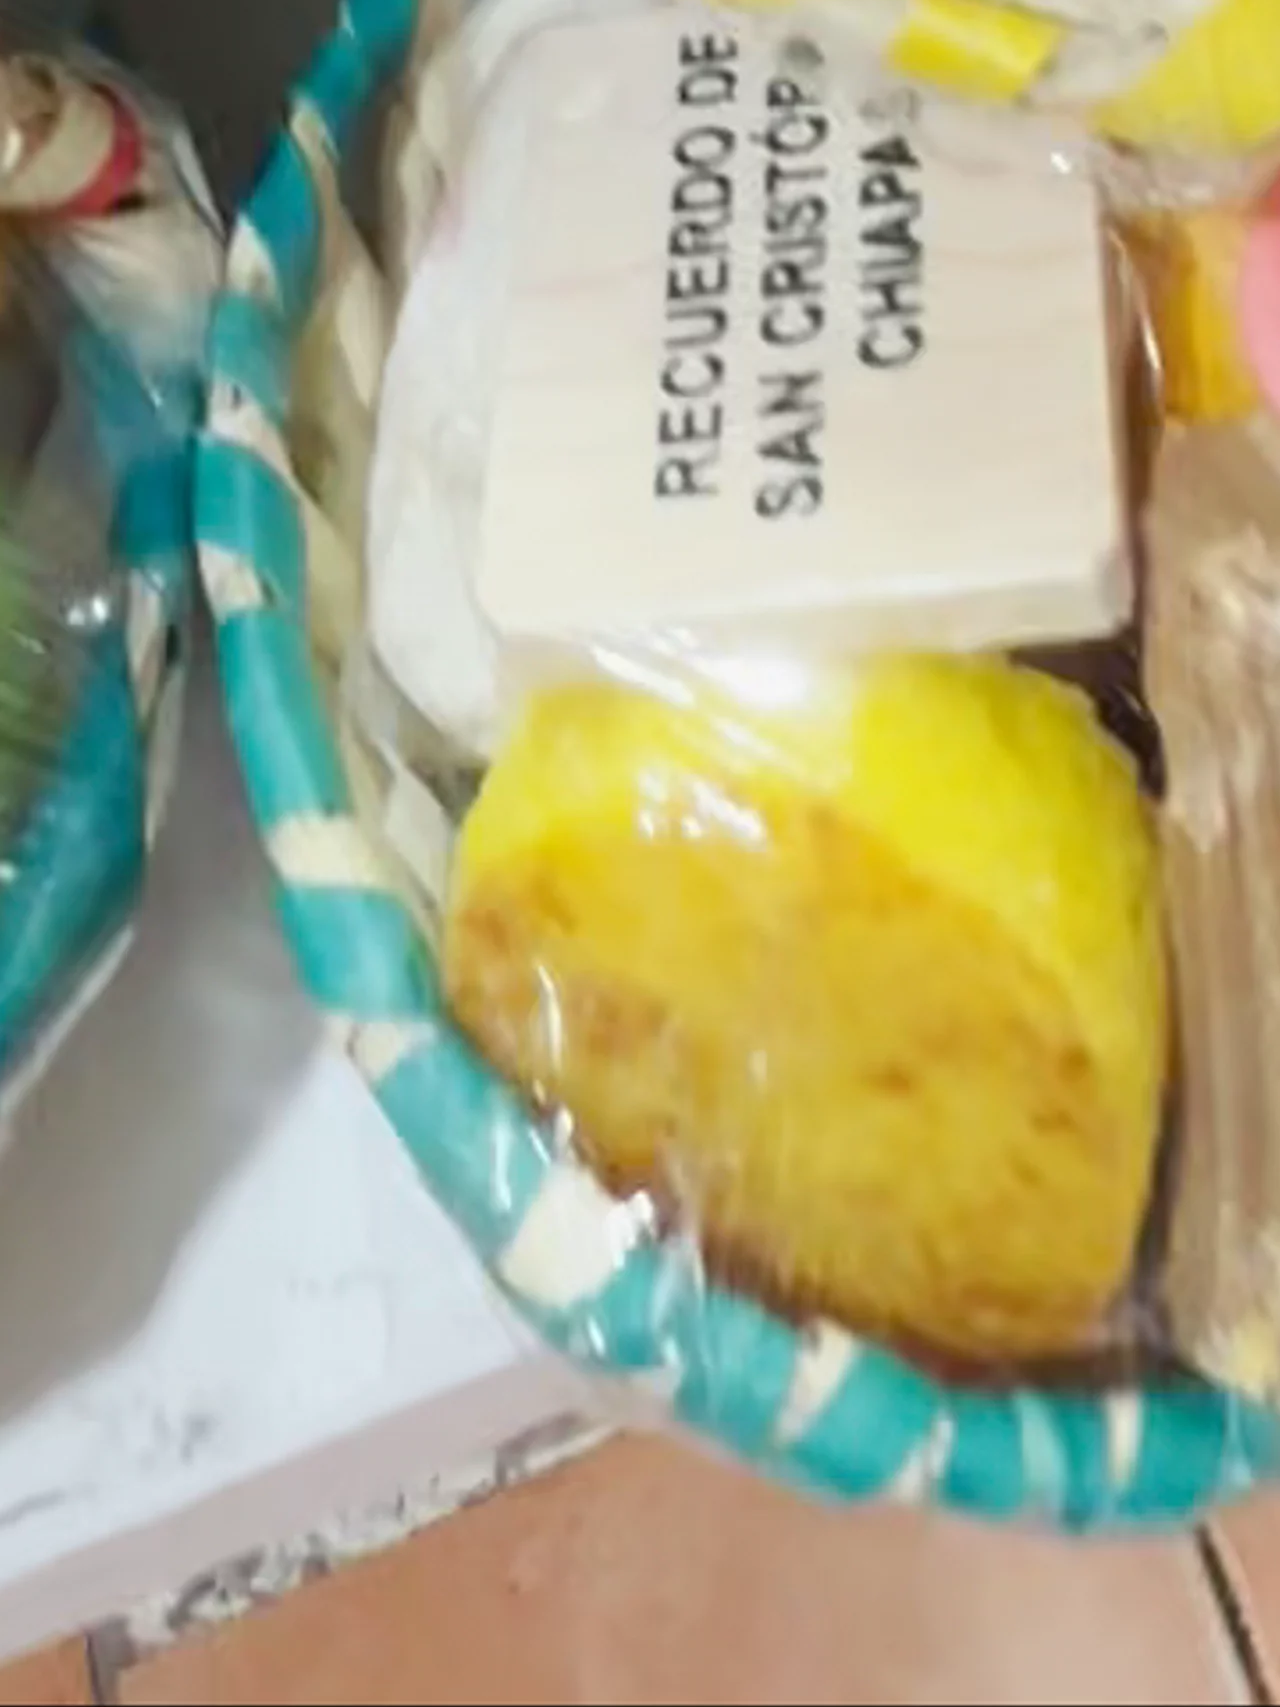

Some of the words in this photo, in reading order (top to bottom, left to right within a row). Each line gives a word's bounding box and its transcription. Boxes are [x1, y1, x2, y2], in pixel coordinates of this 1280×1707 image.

[679, 32, 739, 106] DE
[655, 125, 736, 499] RECUERDO
[754, 370, 824, 521] SAN
